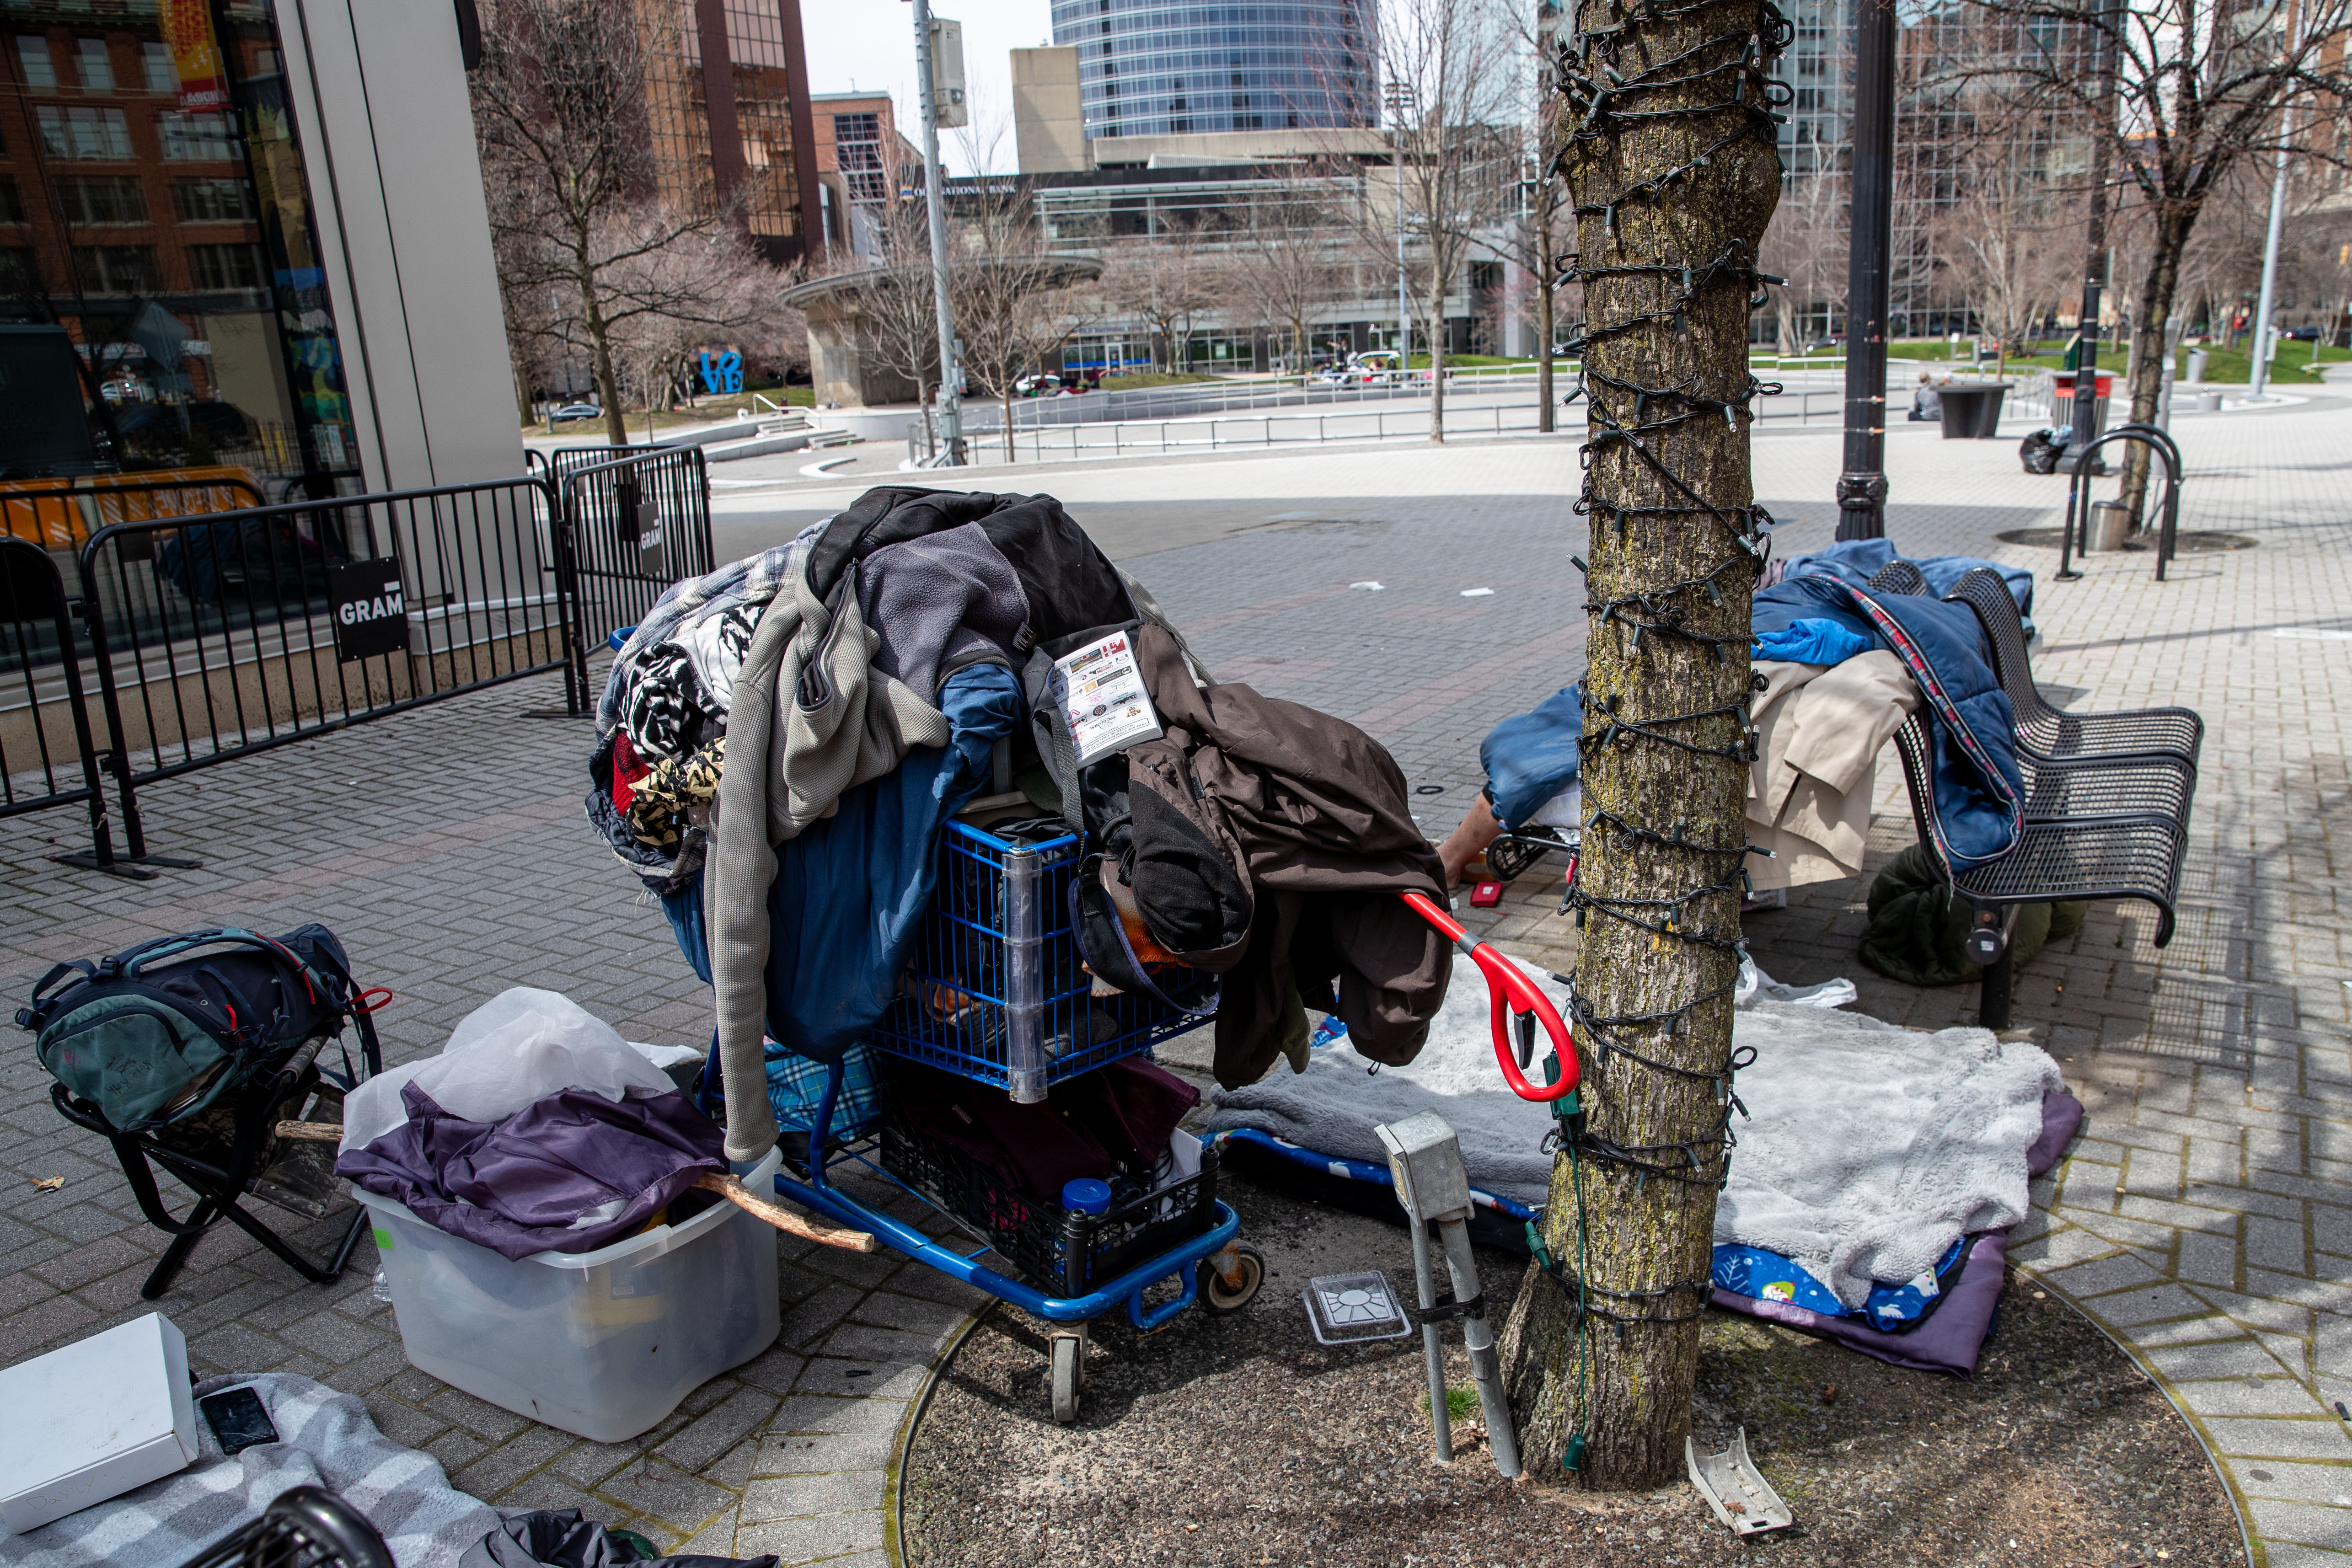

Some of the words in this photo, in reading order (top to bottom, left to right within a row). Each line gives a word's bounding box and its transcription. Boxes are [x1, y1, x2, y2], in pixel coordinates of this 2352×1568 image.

[914, 187, 927, 197] OL
[989, 184, 1017, 194] BANK
[641, 528, 661, 550] GRAM
[340, 593, 403, 626] GRAM
[1089, 719, 1107, 730] GLOBAL
[1116, 723, 1134, 733] SUCCEED
